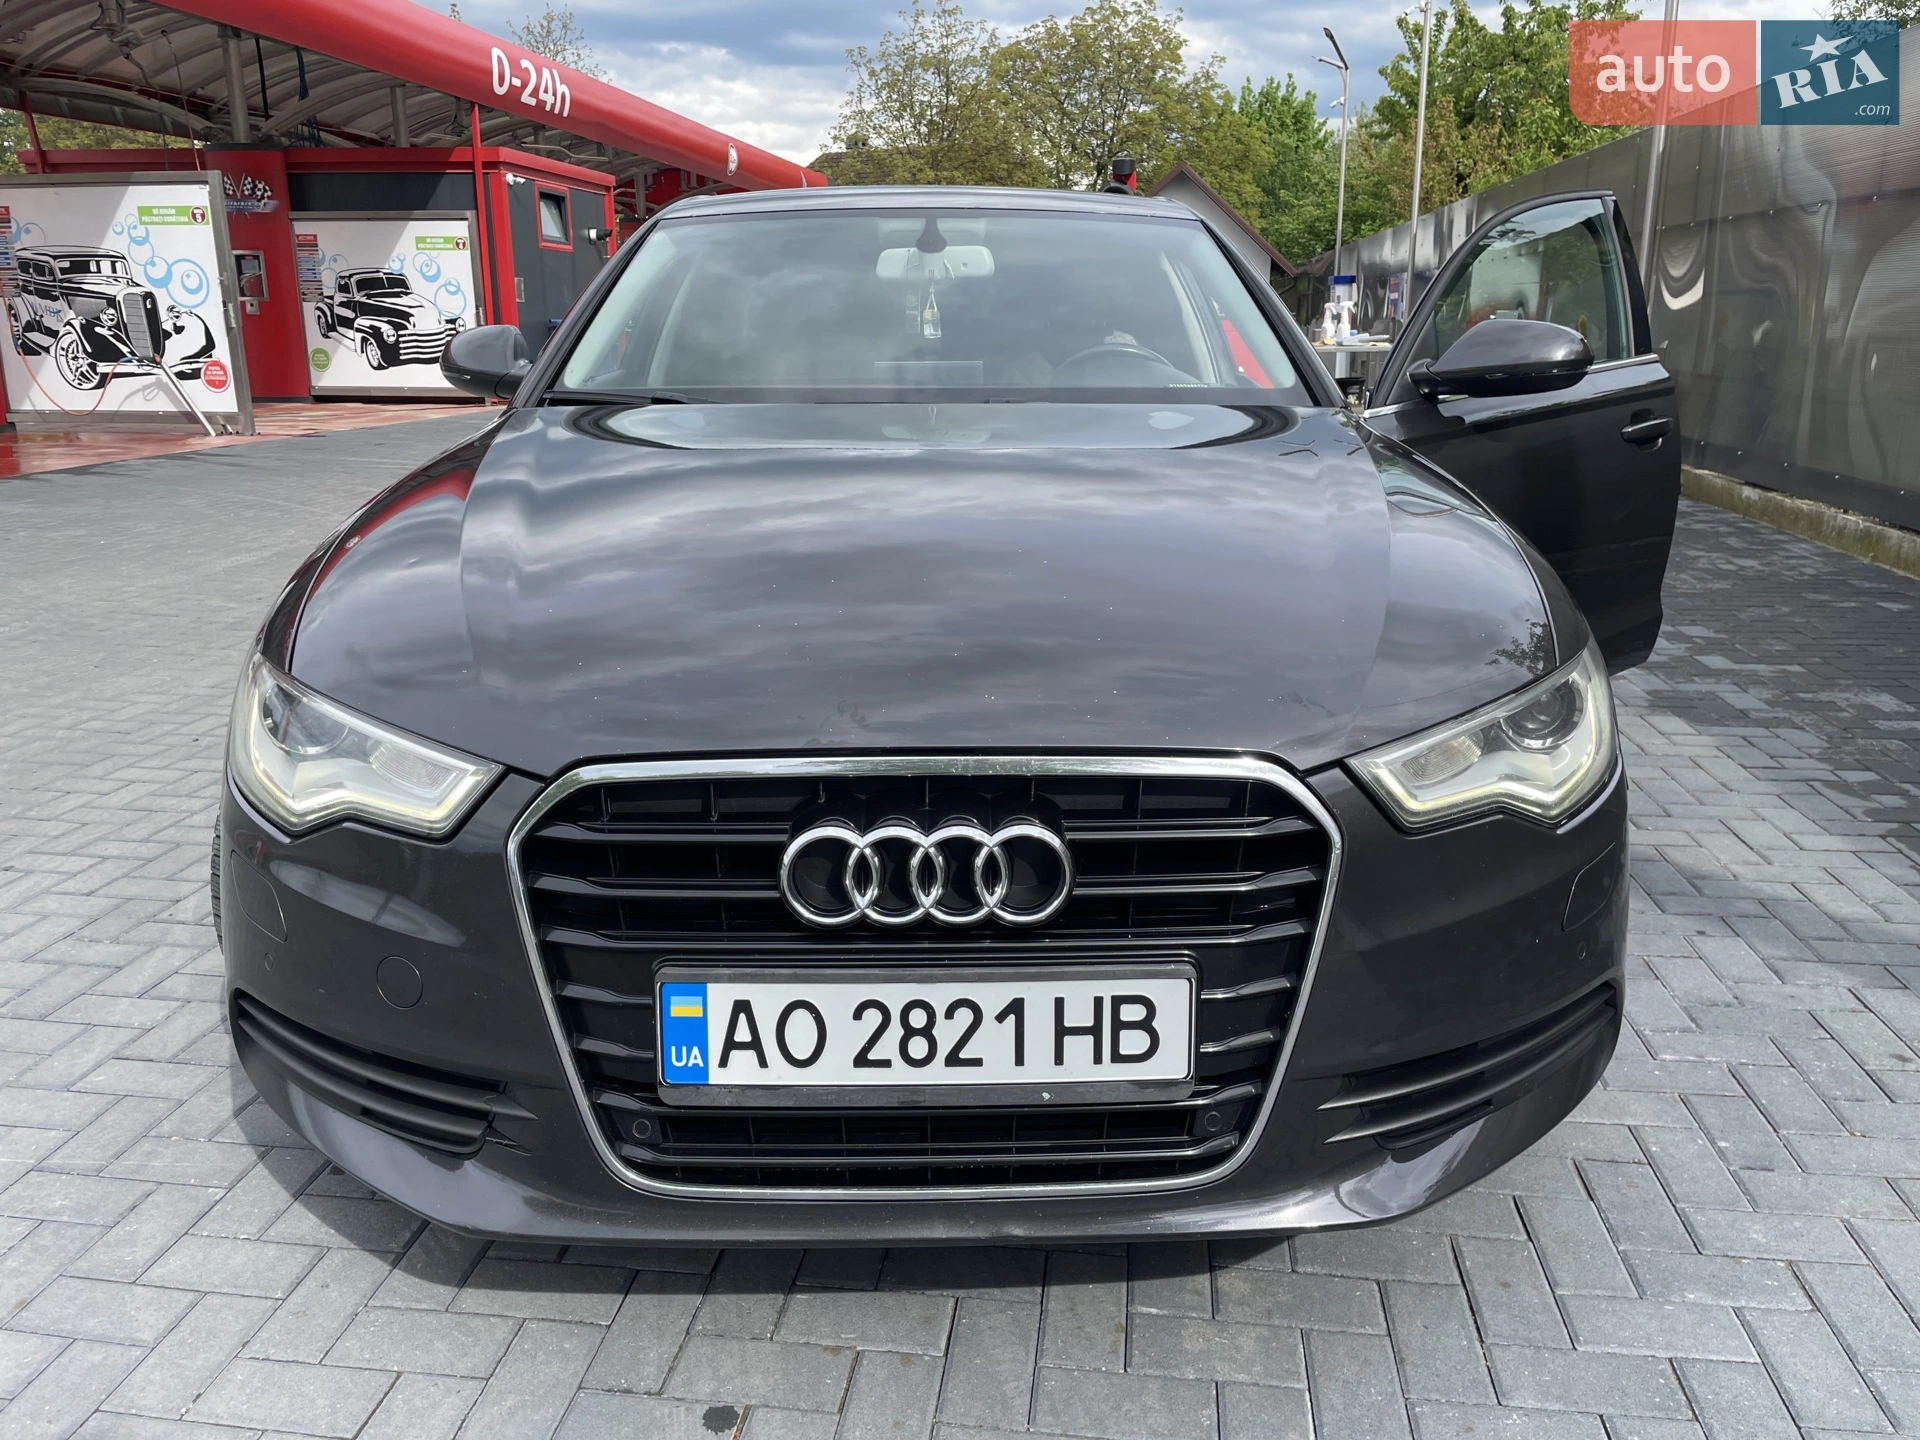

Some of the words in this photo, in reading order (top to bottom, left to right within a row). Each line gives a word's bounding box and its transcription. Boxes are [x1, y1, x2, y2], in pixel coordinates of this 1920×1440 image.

[196, 213, 202, 223] 5
[718, 999, 828, 1069] AO
[852, 996, 1026, 1069] 2821
[1053, 994, 1161, 1067] HB
[671, 1046, 704, 1068] UA
